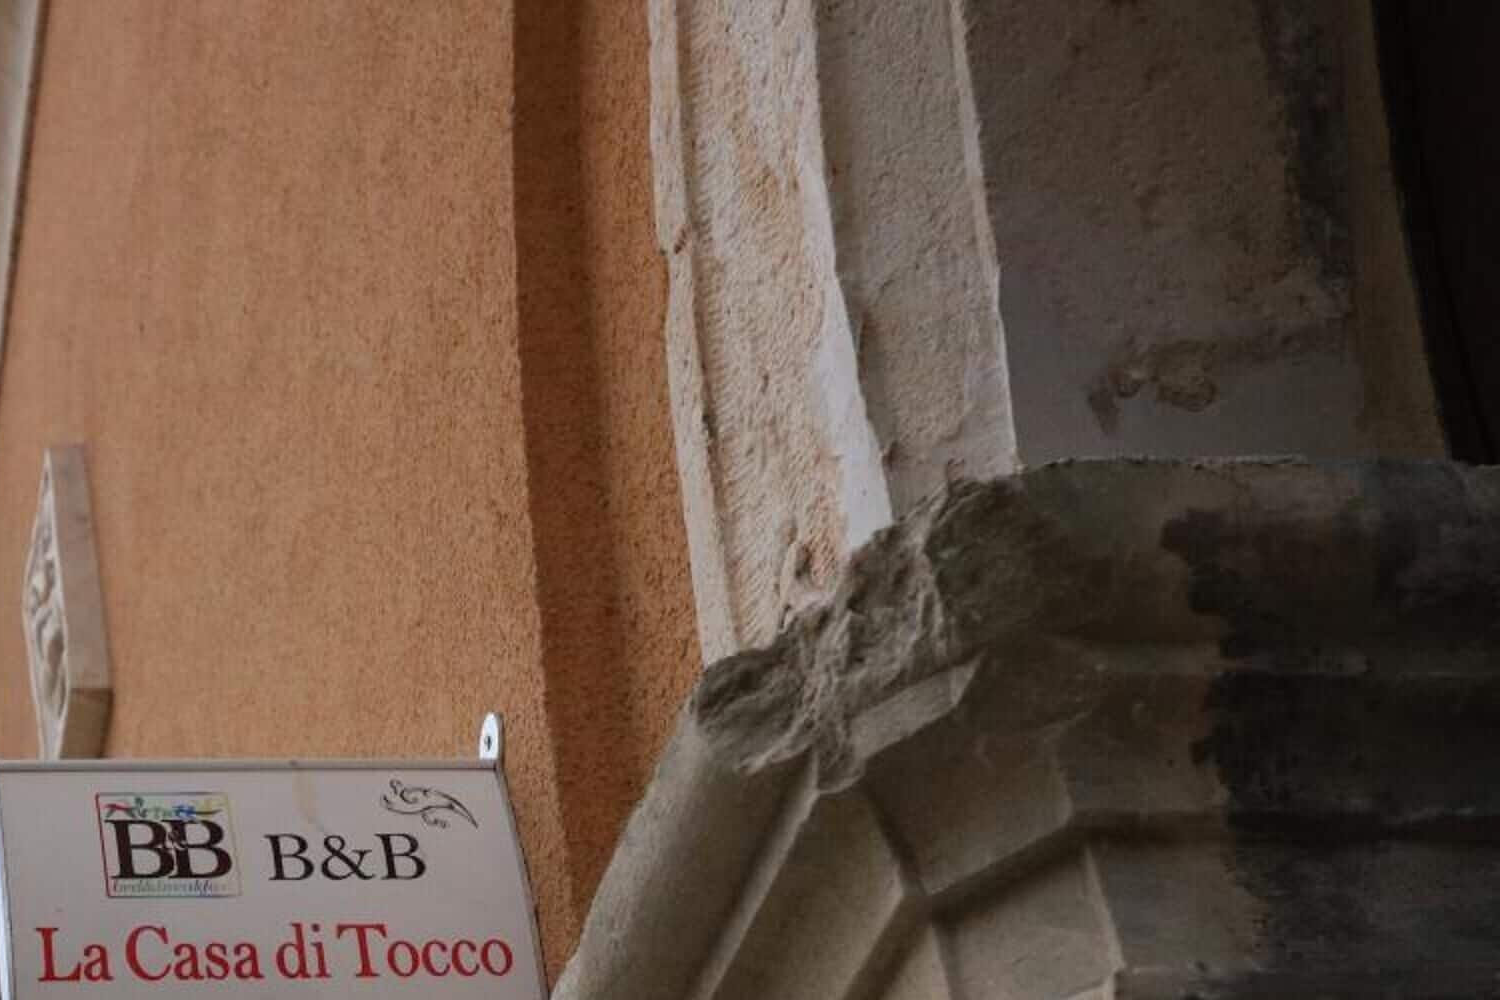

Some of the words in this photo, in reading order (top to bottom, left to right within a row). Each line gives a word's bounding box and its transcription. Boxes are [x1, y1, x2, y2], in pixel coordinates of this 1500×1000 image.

[264, 832, 427, 881] B&B
[35, 926, 113, 983] La
[125, 925, 264, 982] Casa
[274, 922, 331, 980] di
[336, 922, 514, 982] Tocco
